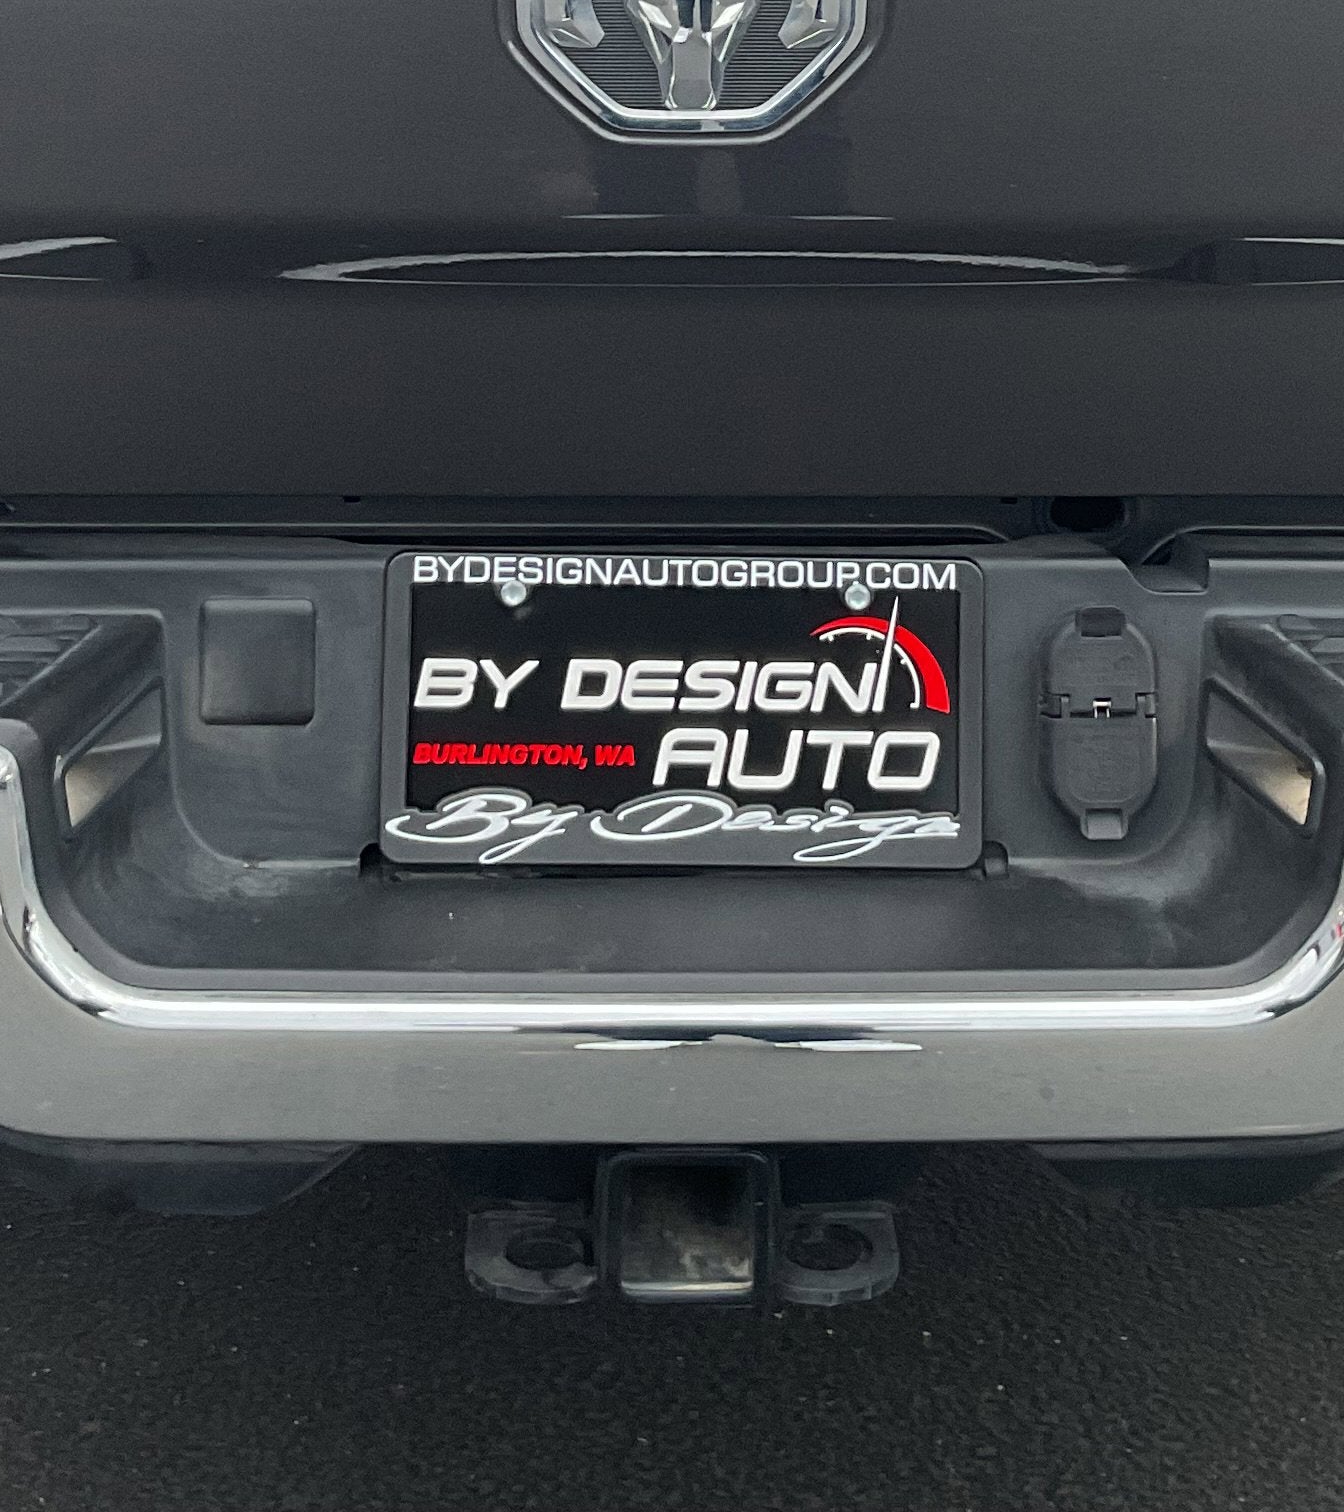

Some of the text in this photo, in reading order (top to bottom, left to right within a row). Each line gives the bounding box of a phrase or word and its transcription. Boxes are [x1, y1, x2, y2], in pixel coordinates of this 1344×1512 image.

[412, 555, 958, 591] BYDESIGNAUTOGROUP.COM
[413, 657, 878, 713] BY DESIGN
[412, 742, 636, 770] BURLINGTON, WA
[652, 727, 941, 791] AUTO
[384, 793, 961, 865] By Design
